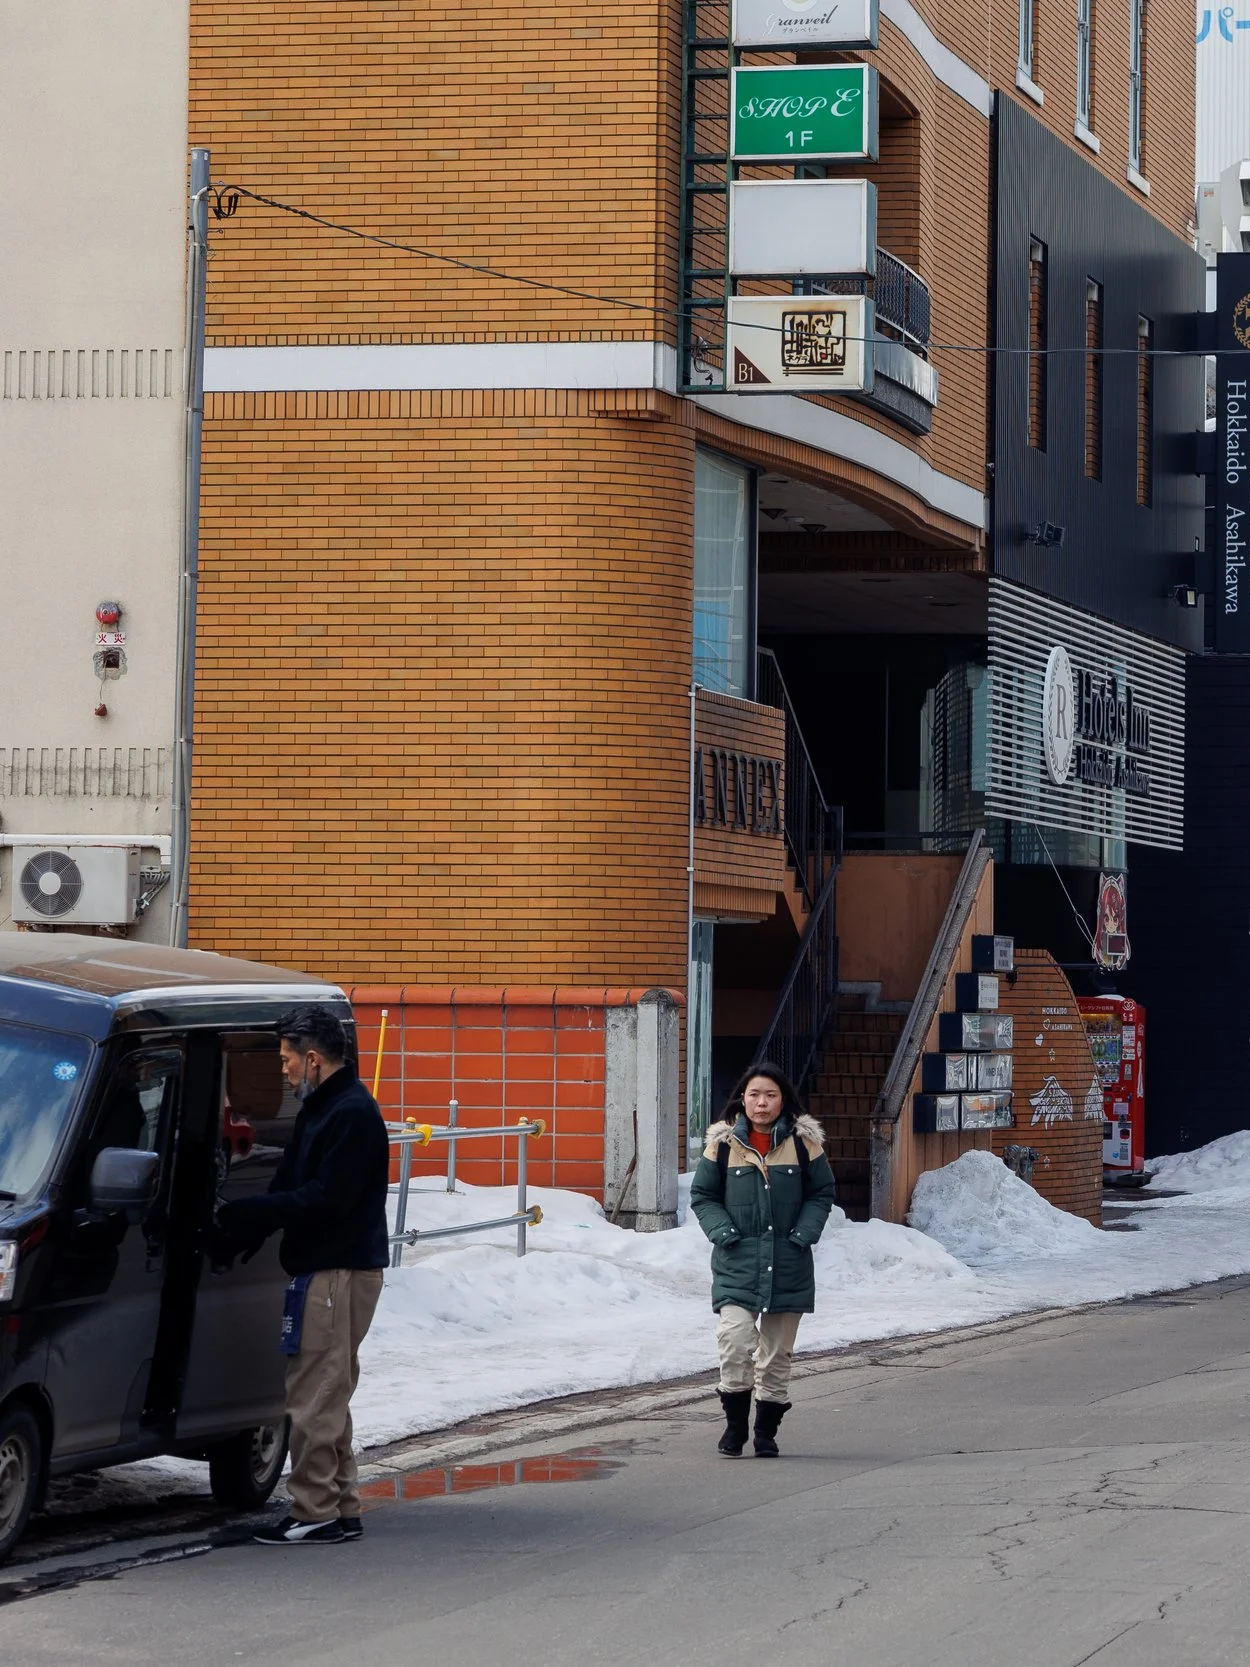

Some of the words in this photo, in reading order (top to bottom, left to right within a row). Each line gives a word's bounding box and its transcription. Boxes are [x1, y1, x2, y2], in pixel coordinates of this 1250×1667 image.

[785, 130, 814, 147] 1F
[738, 363, 754, 382] B1
[1226, 379, 1247, 485] Hokkaido
[1225, 503, 1247, 615] Asahikawa
[98, 633, 123, 644] 火災
[1078, 669, 1126, 744] Hotels
[692, 746, 783, 835] ANNEX
